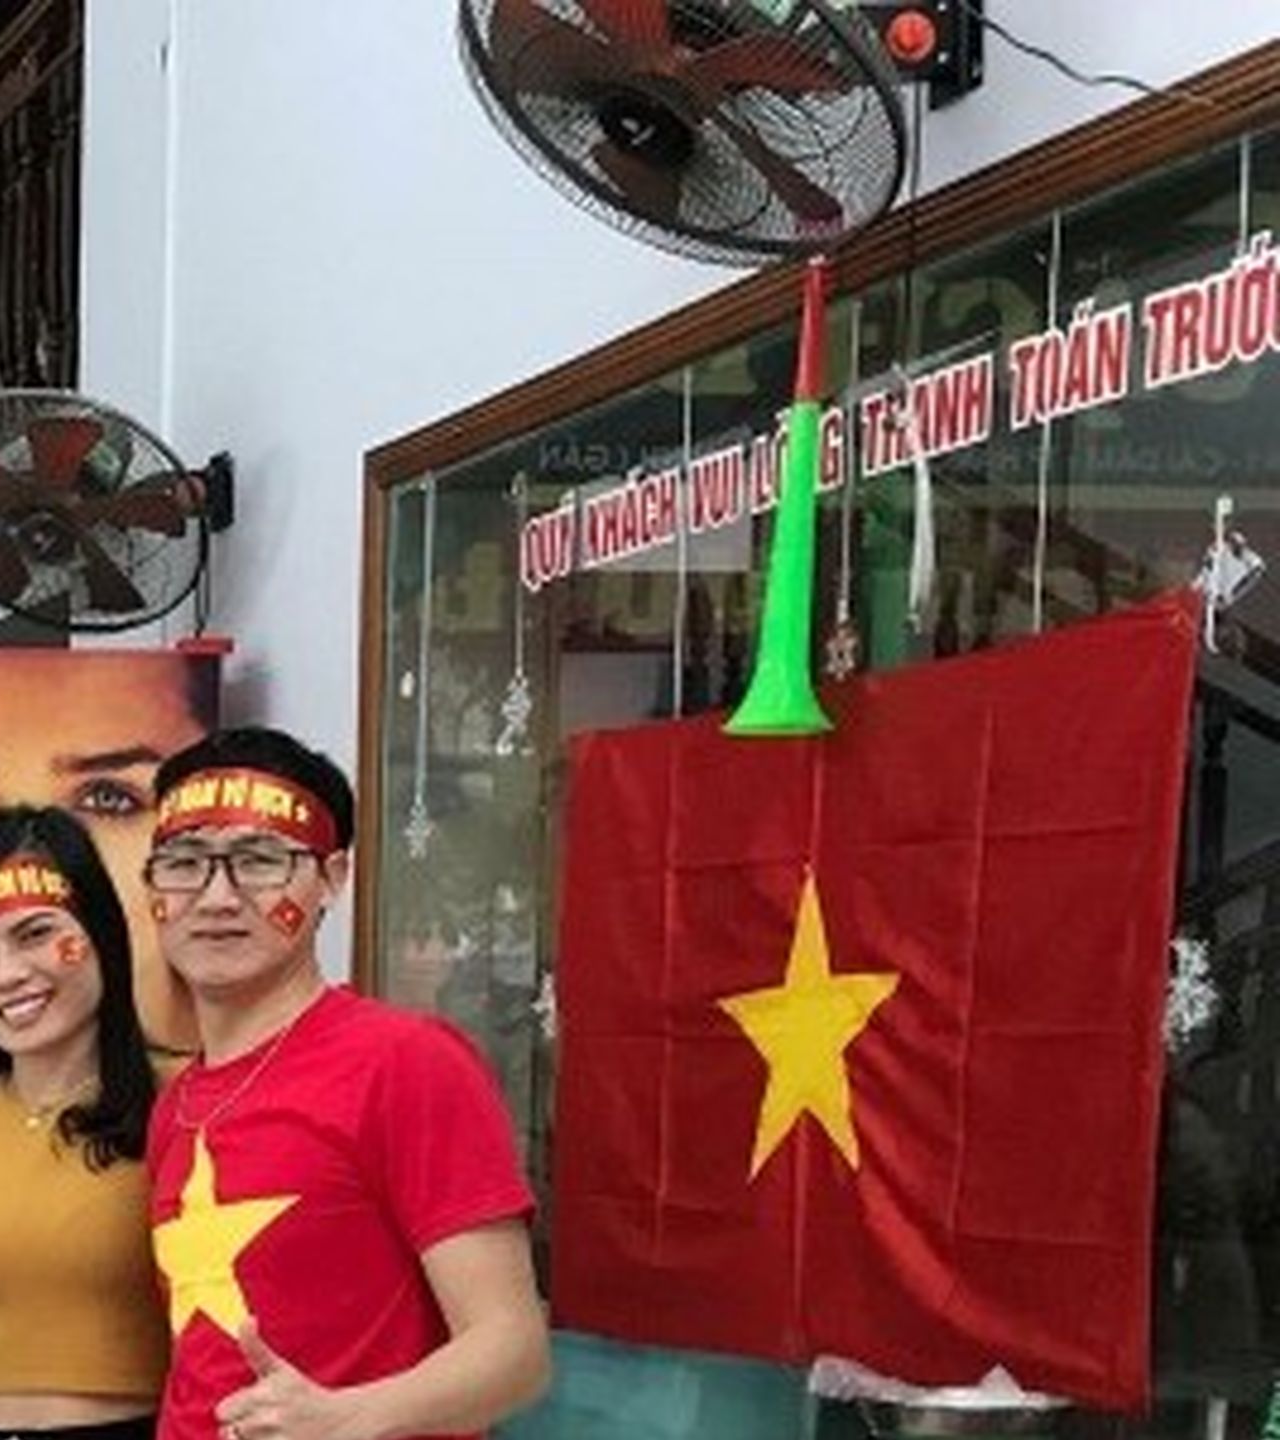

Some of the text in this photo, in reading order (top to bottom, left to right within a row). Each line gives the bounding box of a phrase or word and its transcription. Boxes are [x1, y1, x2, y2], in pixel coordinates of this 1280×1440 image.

[521, 490, 575, 592] QUÝ
[582, 466, 680, 569] KHÁCH
[689, 445, 744, 533] VUI
